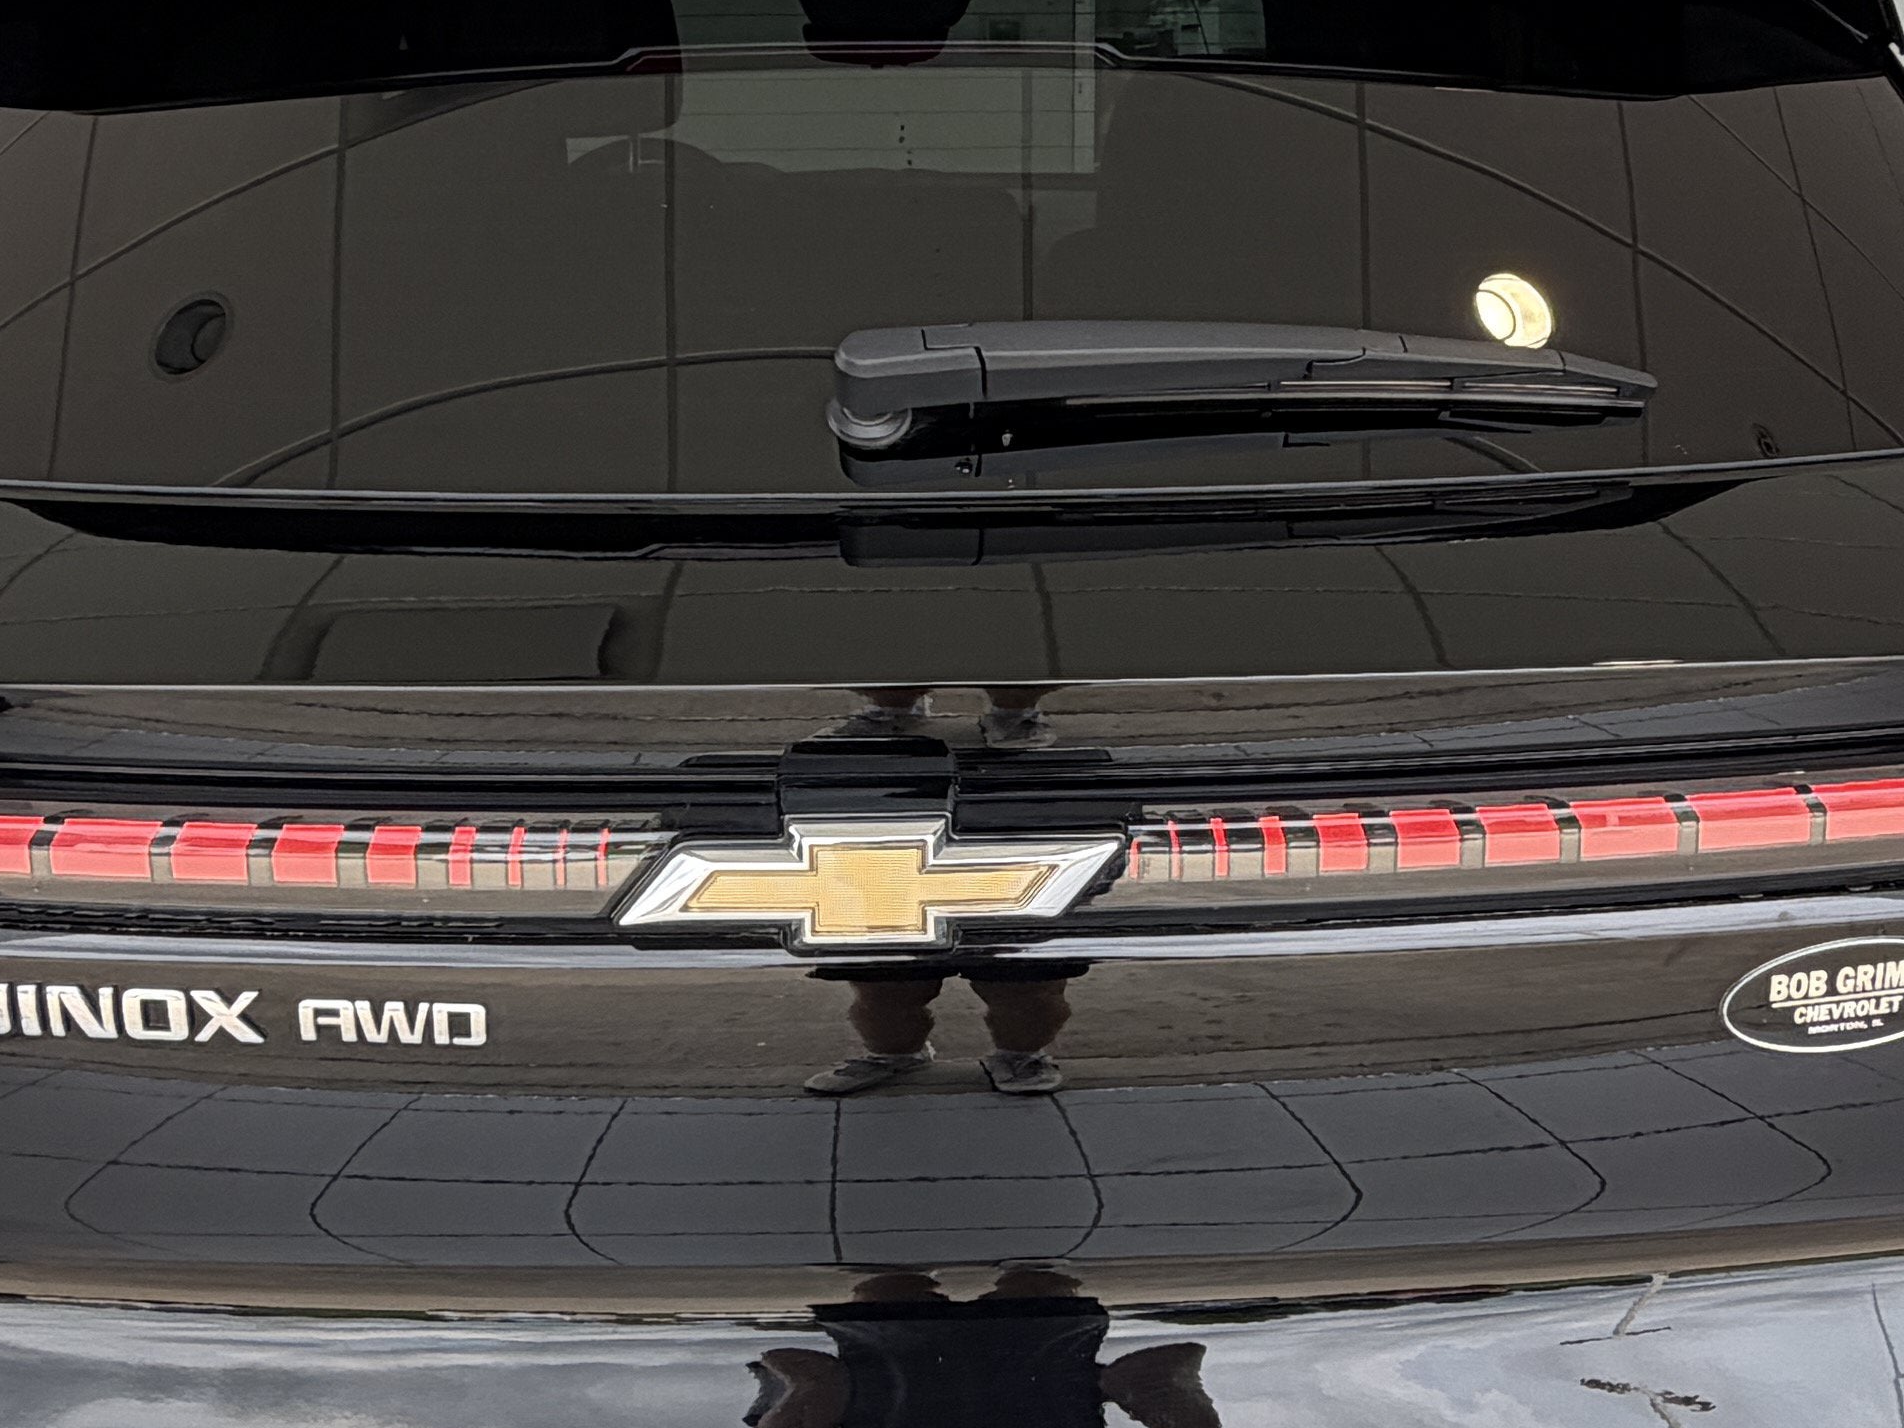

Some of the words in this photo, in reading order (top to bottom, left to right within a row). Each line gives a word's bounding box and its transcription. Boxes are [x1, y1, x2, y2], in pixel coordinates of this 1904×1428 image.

[1768, 969, 1829, 1003] BOB
[296, 998, 489, 1047] AWD
[1793, 995, 1904, 1025] CHEVROLET
[1807, 1019, 1869, 1035] MORTON,
